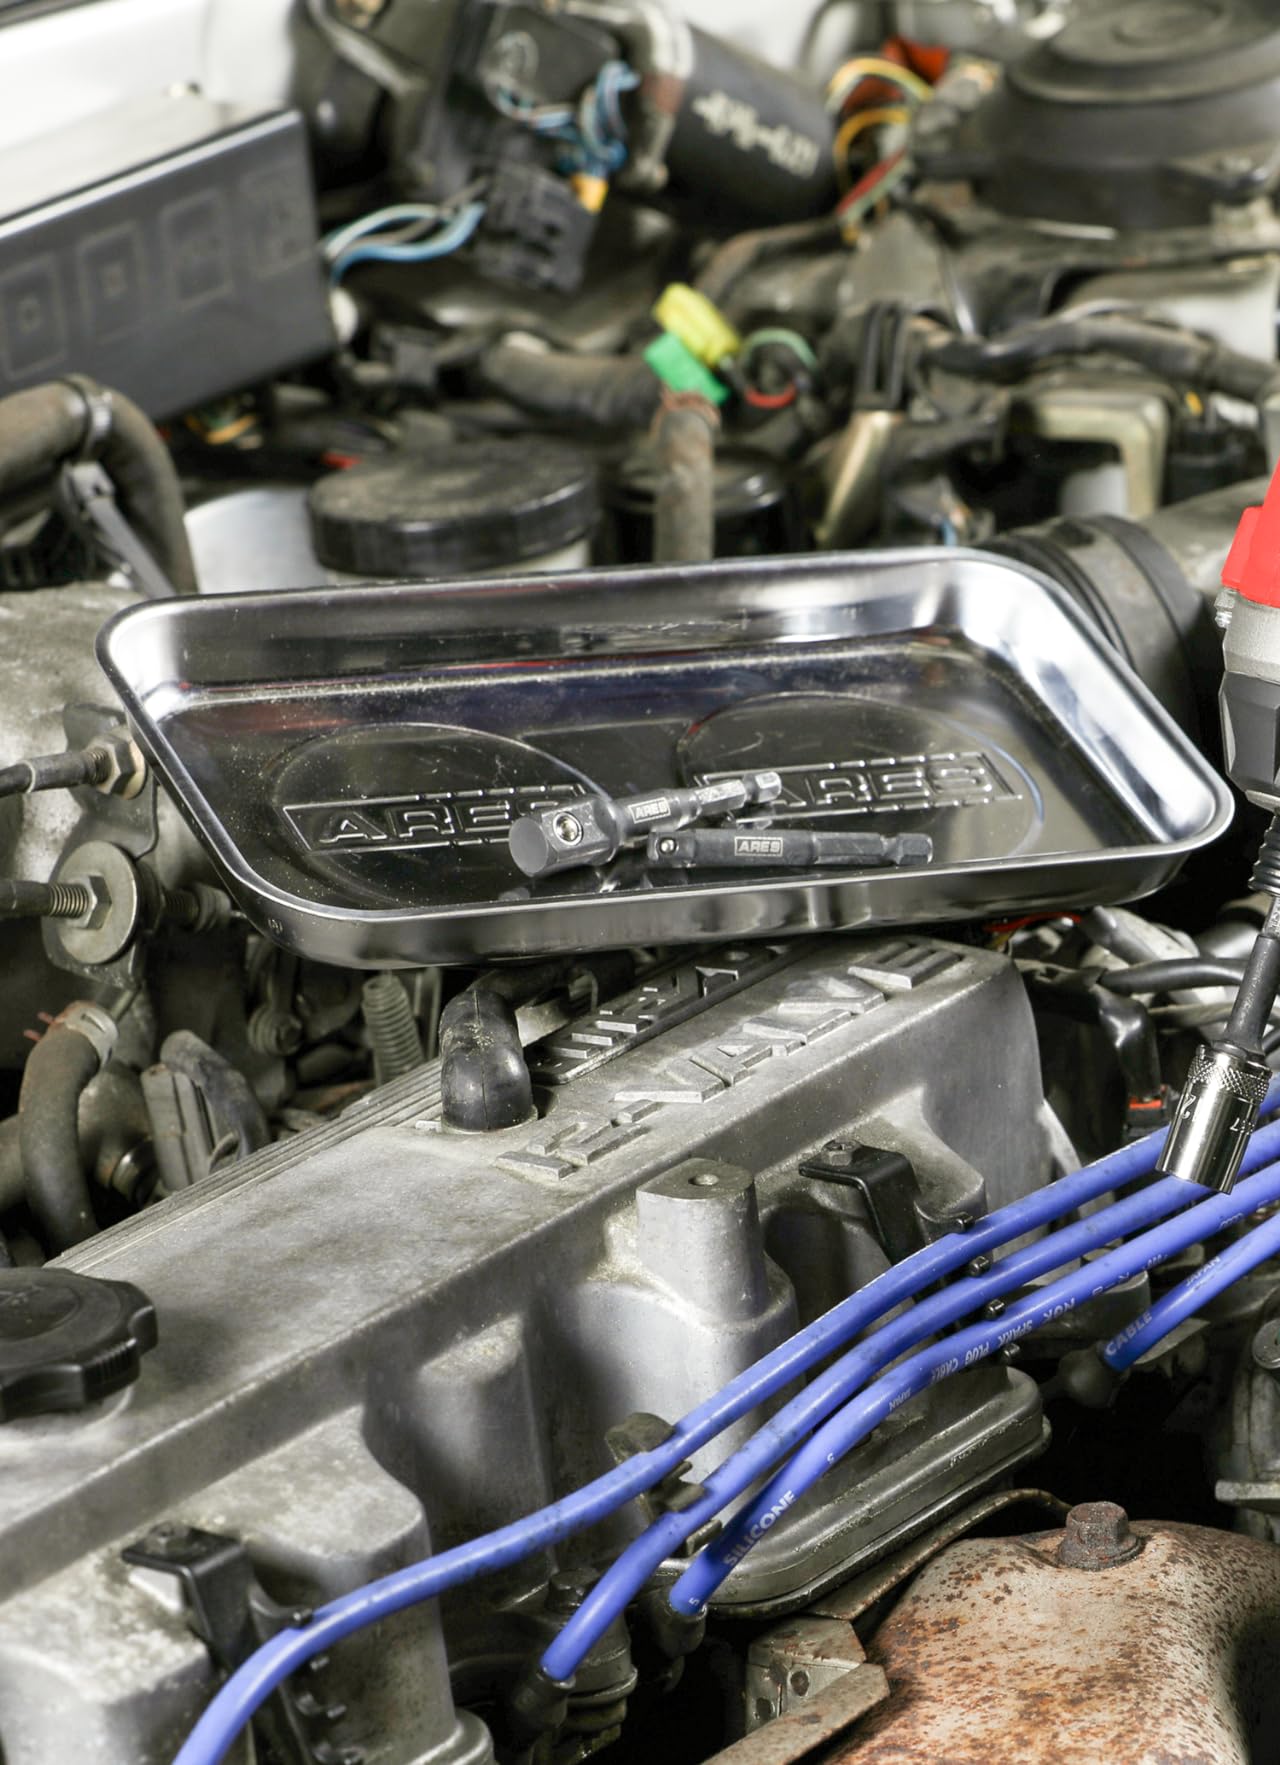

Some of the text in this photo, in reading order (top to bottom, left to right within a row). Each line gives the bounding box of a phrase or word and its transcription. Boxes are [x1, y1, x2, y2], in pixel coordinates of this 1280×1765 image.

[634, 800, 670, 820] ARES
[738, 840, 781, 854] ARES
[1102, 1310, 1154, 1357] CABLE
[721, 1488, 799, 1567] SILICONE
